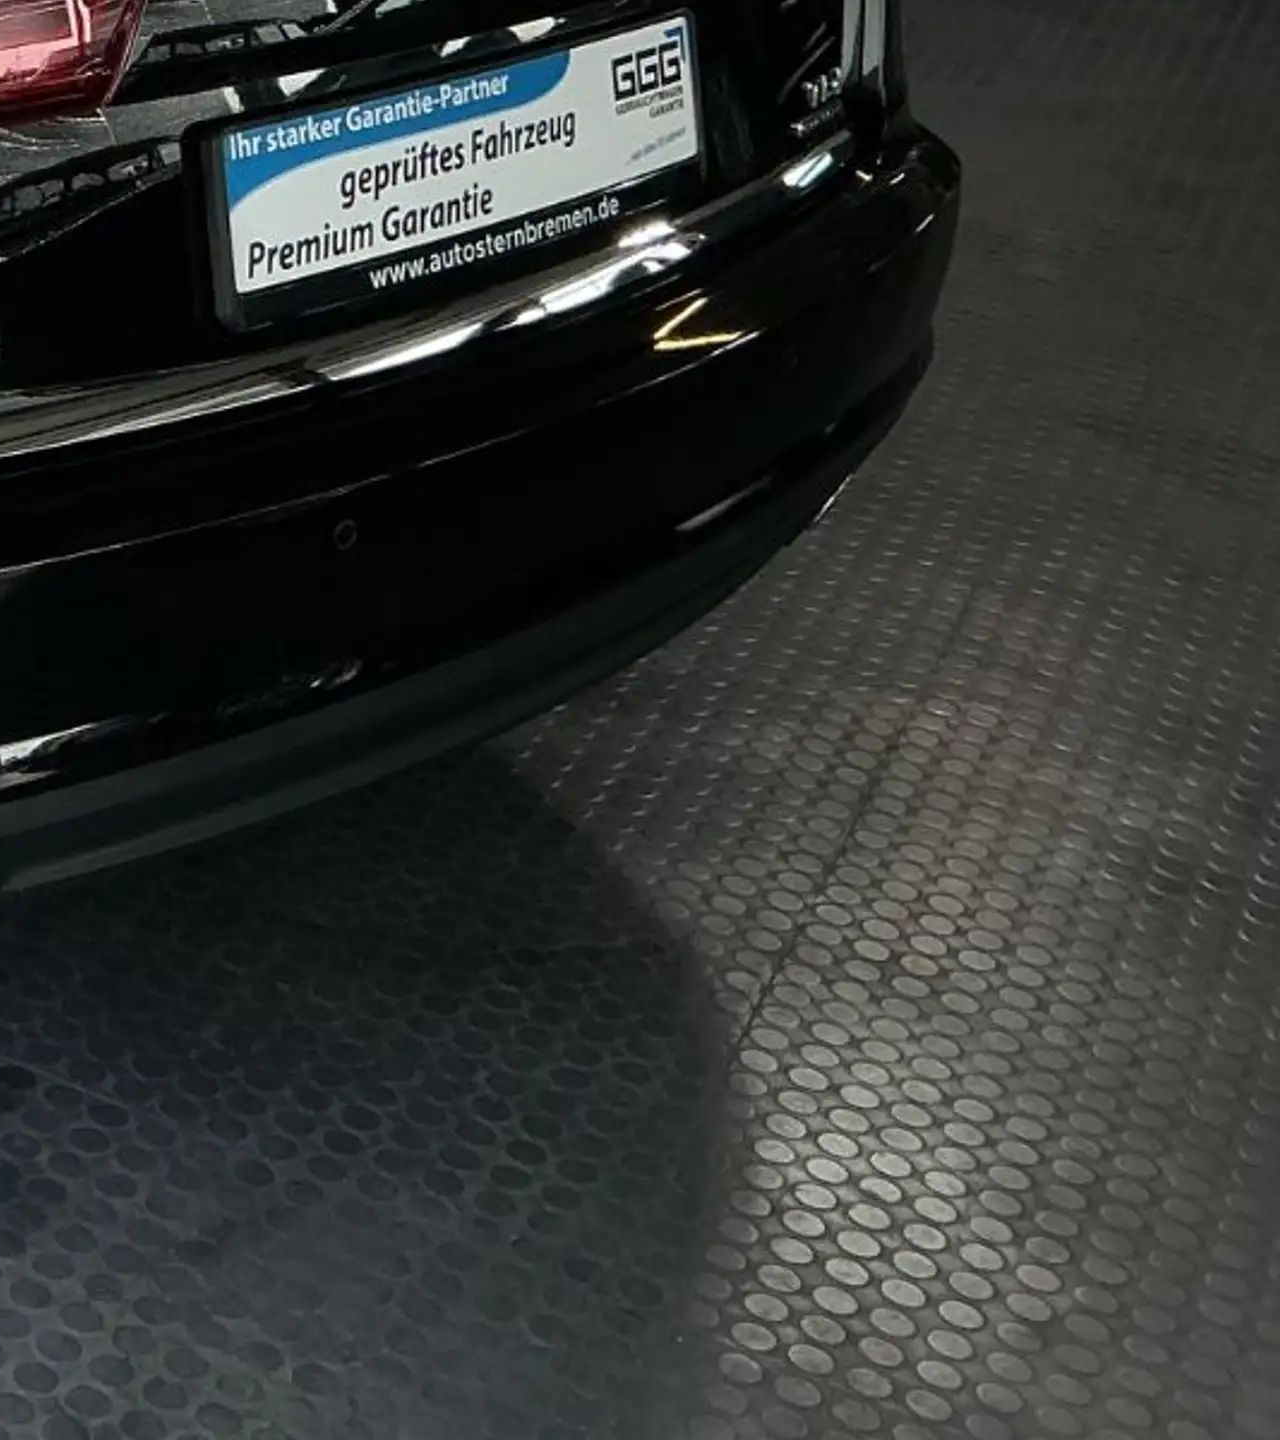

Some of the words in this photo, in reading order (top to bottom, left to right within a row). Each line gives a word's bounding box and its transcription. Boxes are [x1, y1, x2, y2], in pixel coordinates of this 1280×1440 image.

[228, 131, 260, 161] Ihr
[266, 116, 342, 153] starker
[346, 73, 510, 133] Garantie-Partner
[611, 39, 683, 102] GGG
[339, 140, 465, 209] geprüftes
[471, 111, 576, 164] Fahrzeug
[247, 220, 374, 279] Premium
[381, 182, 493, 242] Garantie
[368, 194, 621, 290] www.autosternbremen.de
